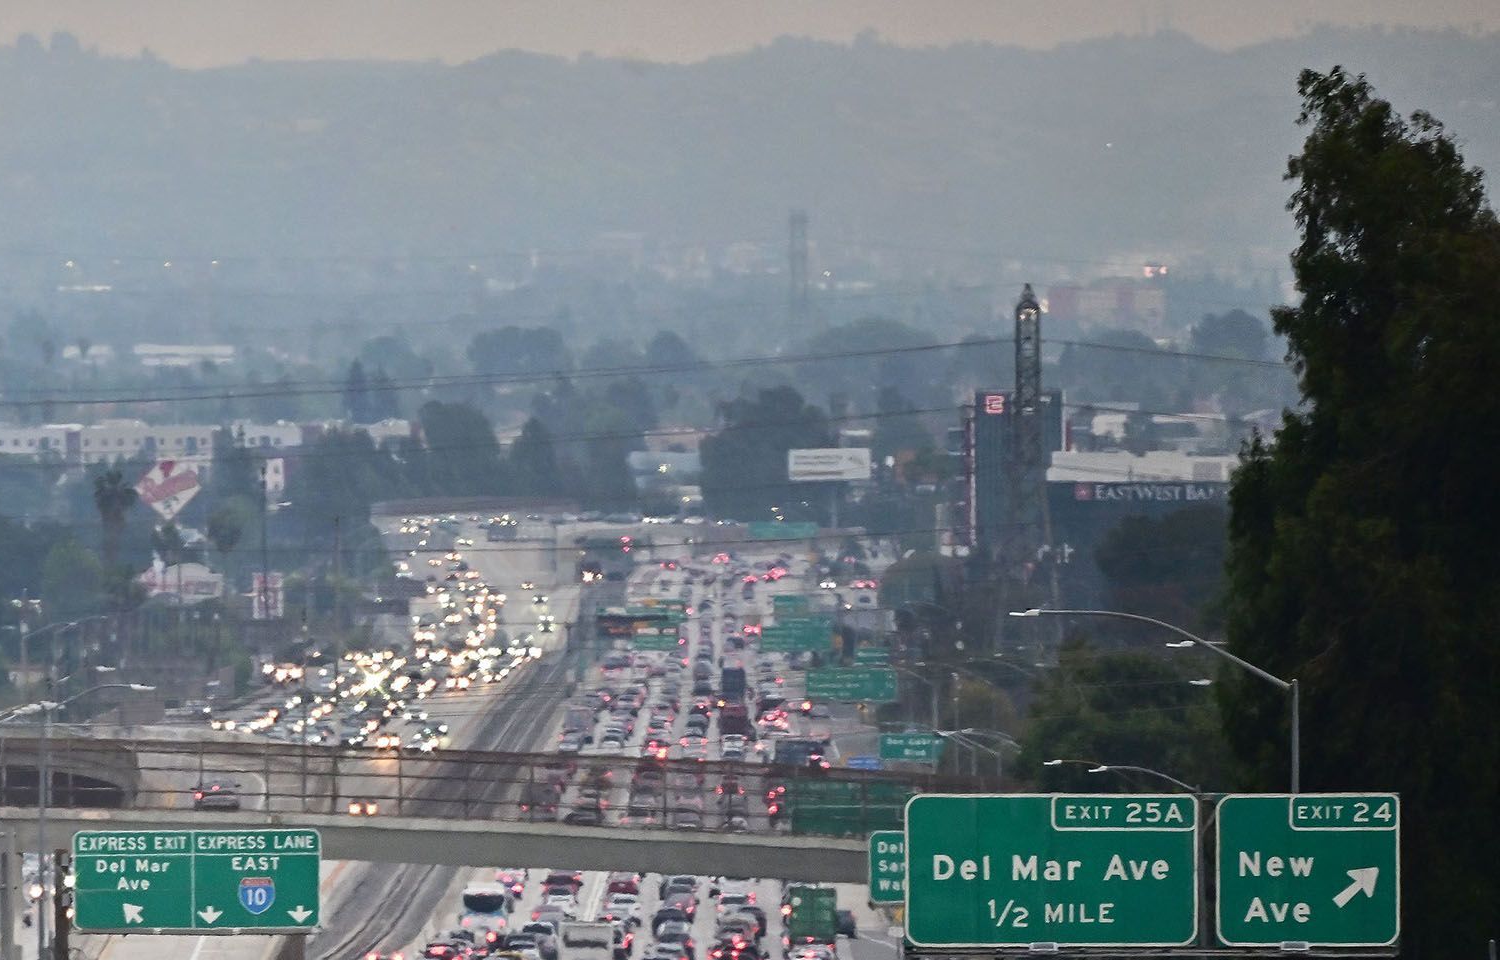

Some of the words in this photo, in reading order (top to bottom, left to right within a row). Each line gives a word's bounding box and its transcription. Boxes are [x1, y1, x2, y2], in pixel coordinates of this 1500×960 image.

[1065, 805, 1112, 820] EXIT
[1125, 802, 1183, 823] 25A
[1297, 805, 1344, 820] EXIT
[1353, 802, 1392, 822] 24
[78, 836, 147, 851] EXPRESS
[154, 836, 186, 850] EXIT
[197, 835, 266, 850] EXPRESS
[274, 835, 315, 849] LANE
[96, 859, 126, 873] Del
[136, 859, 170, 873] Mar
[232, 856, 280, 870] EAST
[933, 854, 990, 881] Del
[1012, 854, 1082, 881] Mar
[1103, 854, 1170, 881] Ave
[1239, 851, 1314, 877] New
[117, 876, 150, 890] Ave
[246, 888, 267, 906] 10
[1044, 903, 1115, 923] MILE
[1244, 897, 1311, 923] Ave
